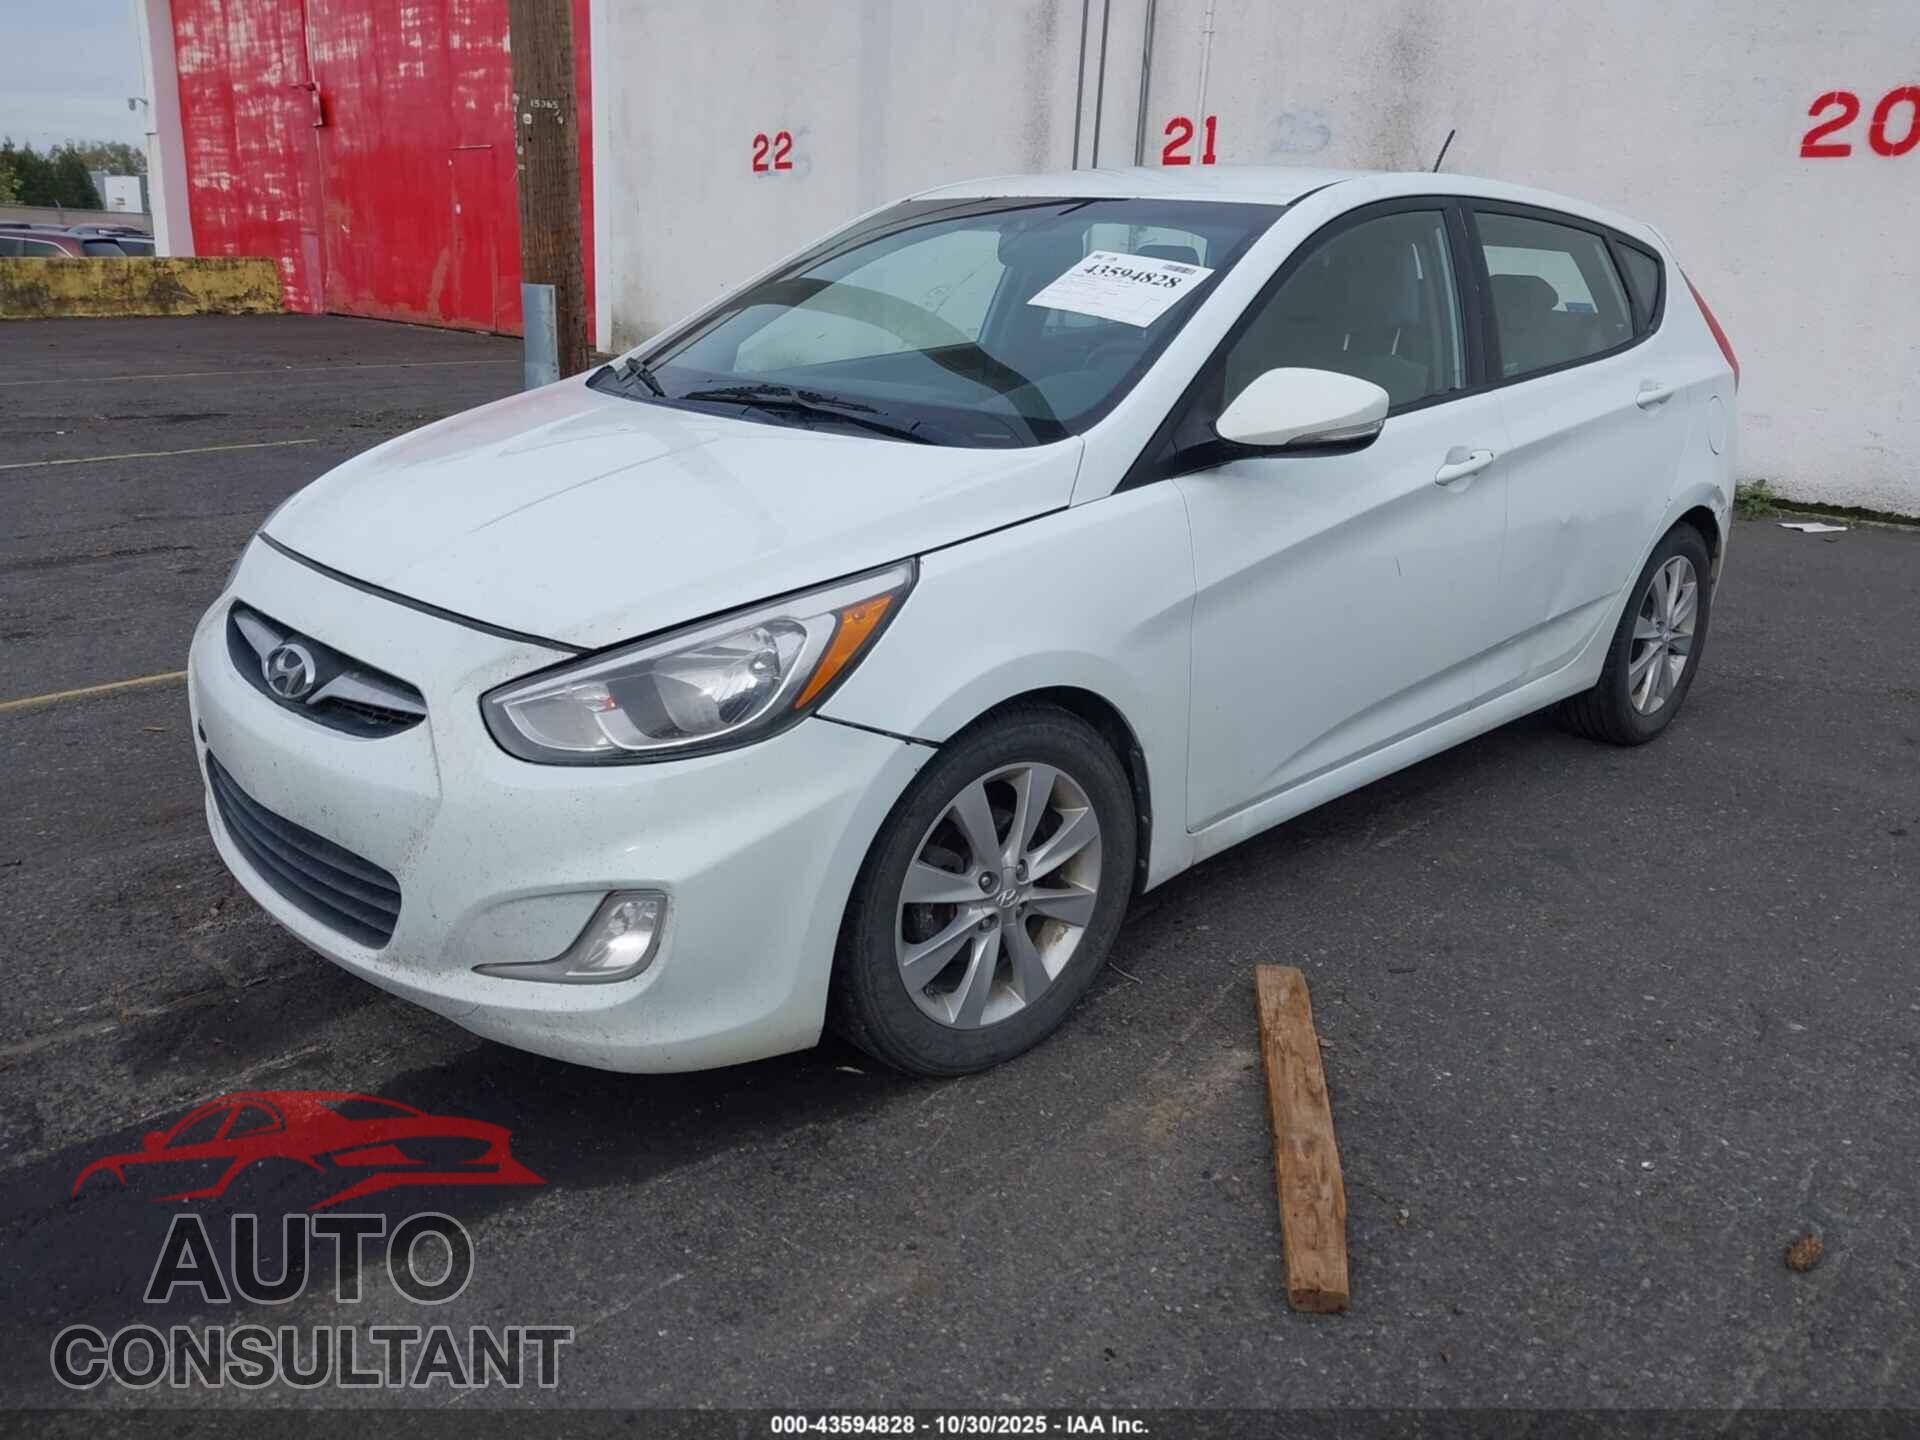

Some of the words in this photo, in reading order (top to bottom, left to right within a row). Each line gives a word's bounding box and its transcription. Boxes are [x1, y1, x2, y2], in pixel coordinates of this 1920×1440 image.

[1162, 116, 1216, 166] 21
[1799, 86, 1920, 159] 20
[752, 131, 793, 172] 22
[1084, 263, 1183, 289] 43594828
